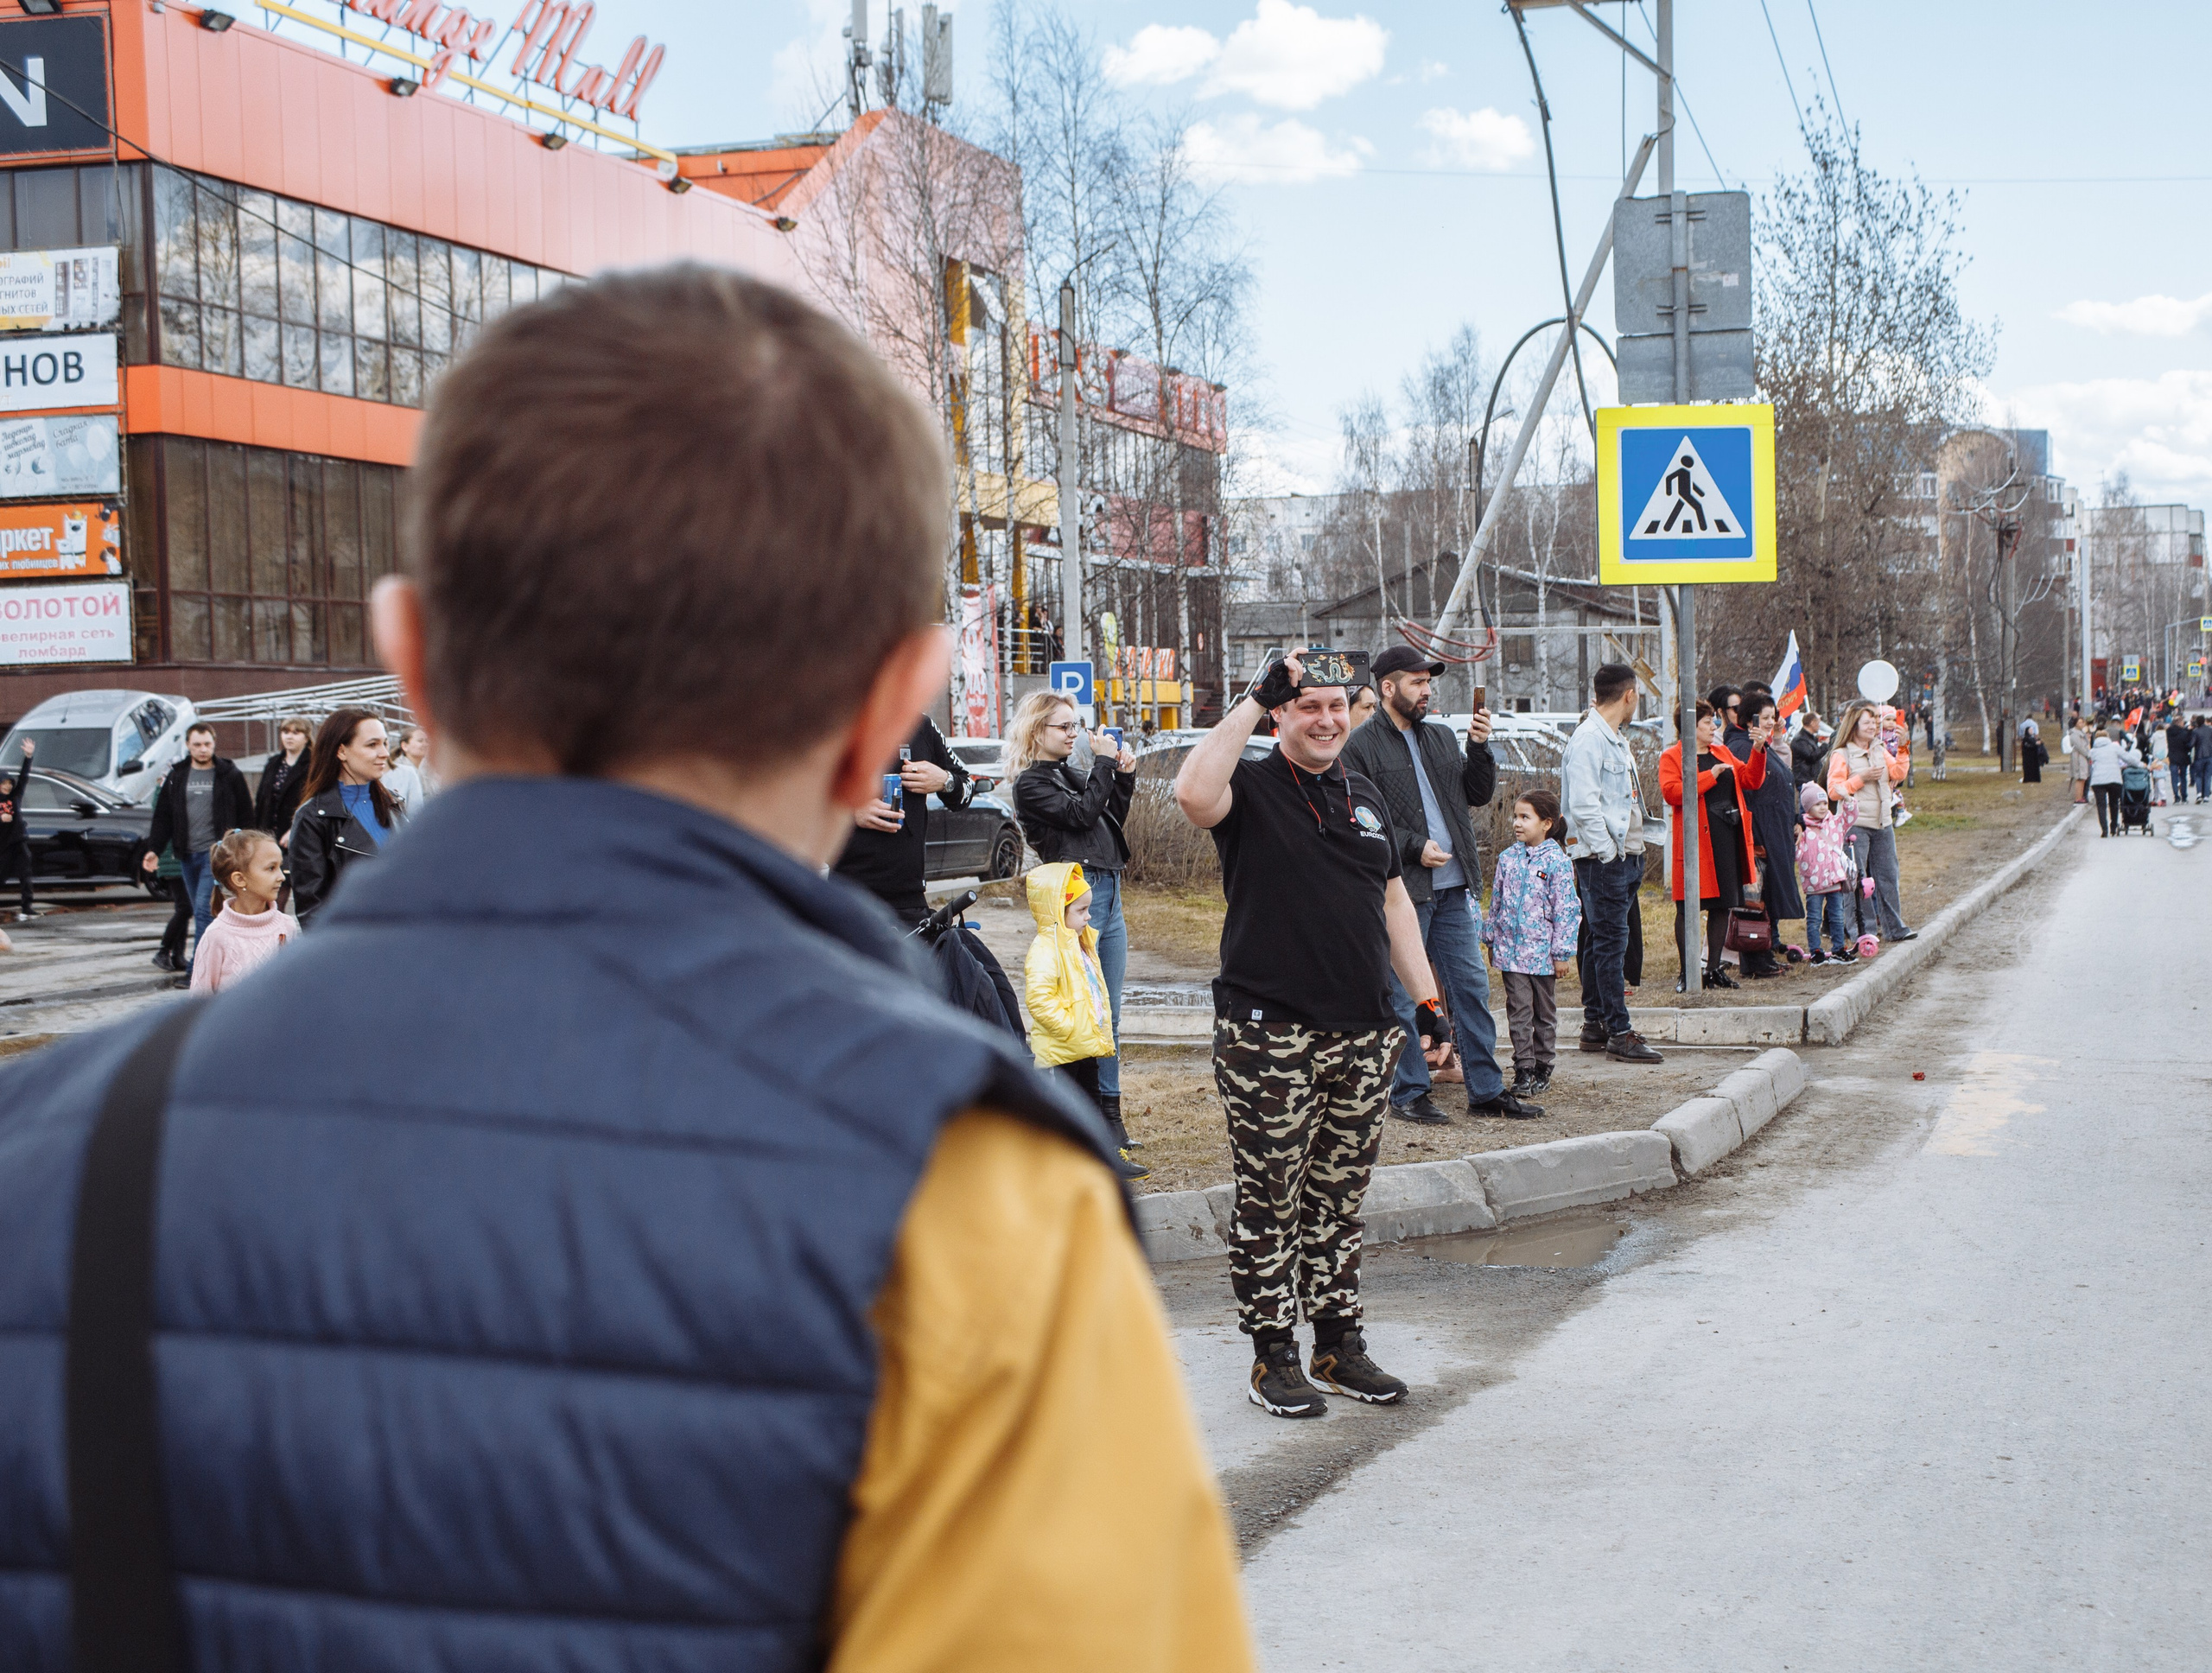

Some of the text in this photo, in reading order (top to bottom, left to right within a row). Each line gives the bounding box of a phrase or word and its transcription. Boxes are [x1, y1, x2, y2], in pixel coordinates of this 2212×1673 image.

[511, 0, 666, 122] Mall
[0, 301, 48, 315] ЫХ СЕТЕЙ
[0, 351, 85, 387] НОВ
[0, 527, 54, 559] ркет
[0, 591, 121, 620] ОЛОТОЙ
[0, 628, 115, 644] велирная сеть
[18, 644, 87, 660] ломбард
[1061, 671, 1085, 695] P
